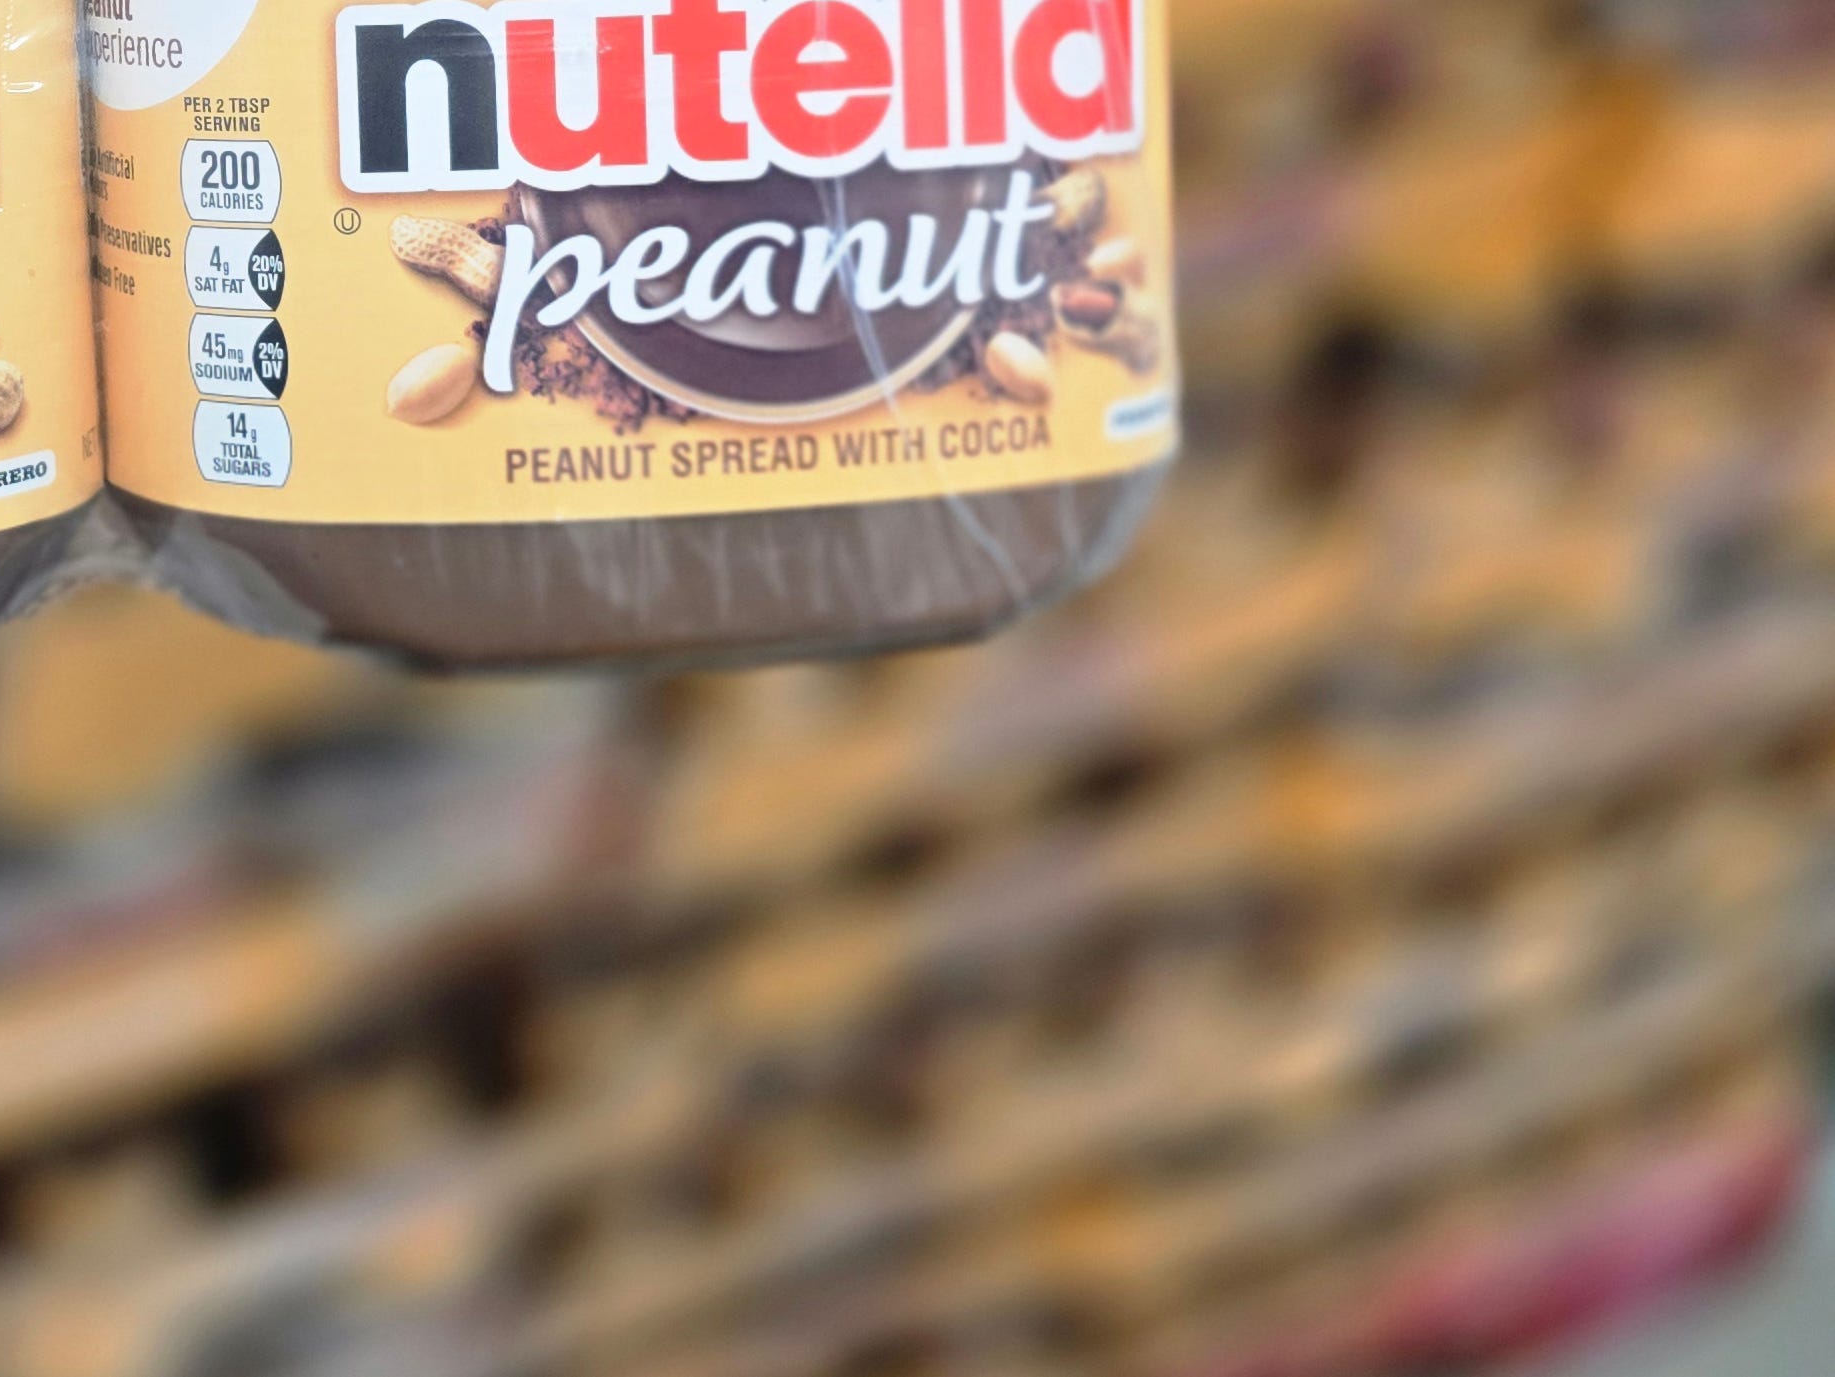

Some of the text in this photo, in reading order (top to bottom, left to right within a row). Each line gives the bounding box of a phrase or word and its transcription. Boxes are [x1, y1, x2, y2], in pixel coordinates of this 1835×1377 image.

[184, 97, 270, 114] PER 2 TBSP
[194, 116, 261, 132] SERVING
[201, 150, 261, 191] 200
[200, 192, 264, 210] CALORIES
[252, 255, 283, 273] 20%
[195, 276, 245, 294] SAT FAT
[257, 272, 279, 291] DV
[483, 169, 1054, 393] peanut
[259, 342, 284, 360] 2%
[195, 363, 253, 382] SODIUM
[262, 360, 283, 379] DV
[220, 441, 262, 460] TOTAL
[504, 414, 1052, 484] PEANUT SPREAD WITH COCOA
[213, 457, 272, 478] SUGARS
